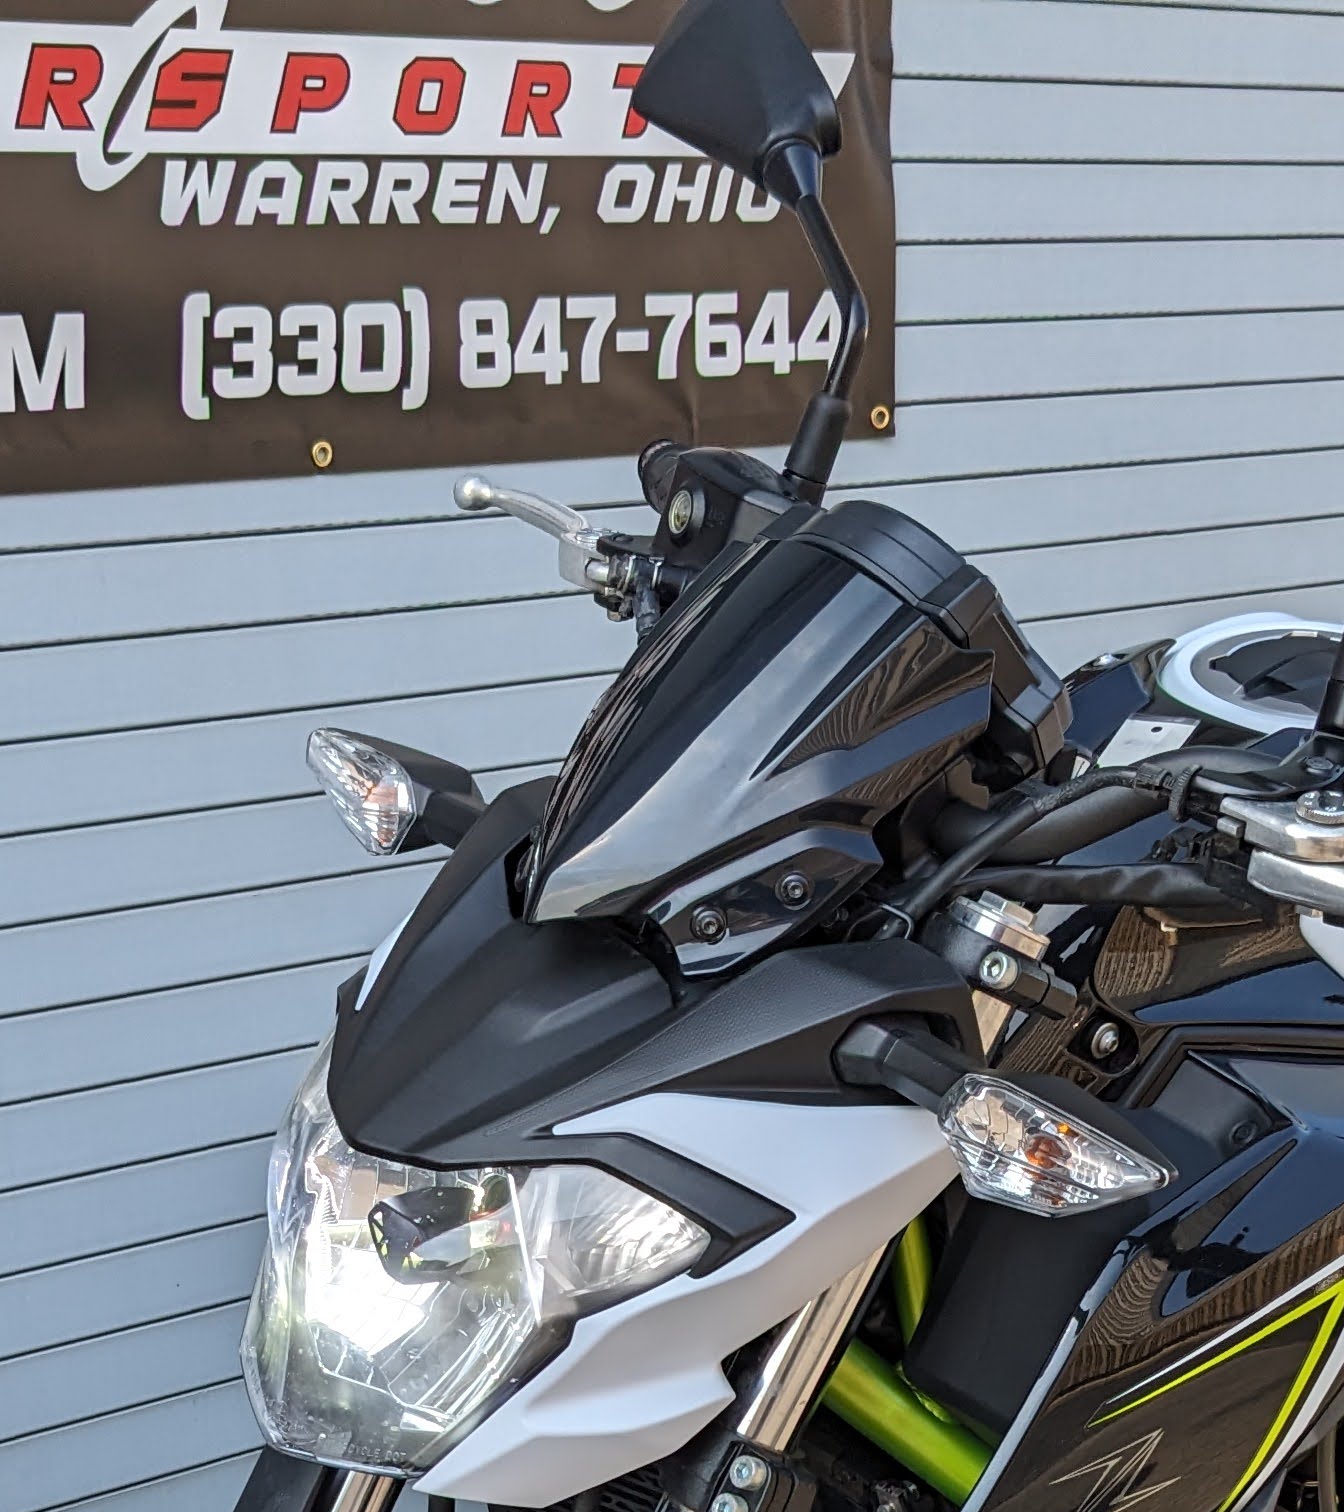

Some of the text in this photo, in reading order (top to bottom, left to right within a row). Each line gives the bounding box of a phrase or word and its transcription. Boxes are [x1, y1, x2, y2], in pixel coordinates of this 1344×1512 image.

[160, 159, 783, 235] WARREN, OHIO
[181, 286, 430, 419] (330)
[458, 289, 843, 389] 847-7644
